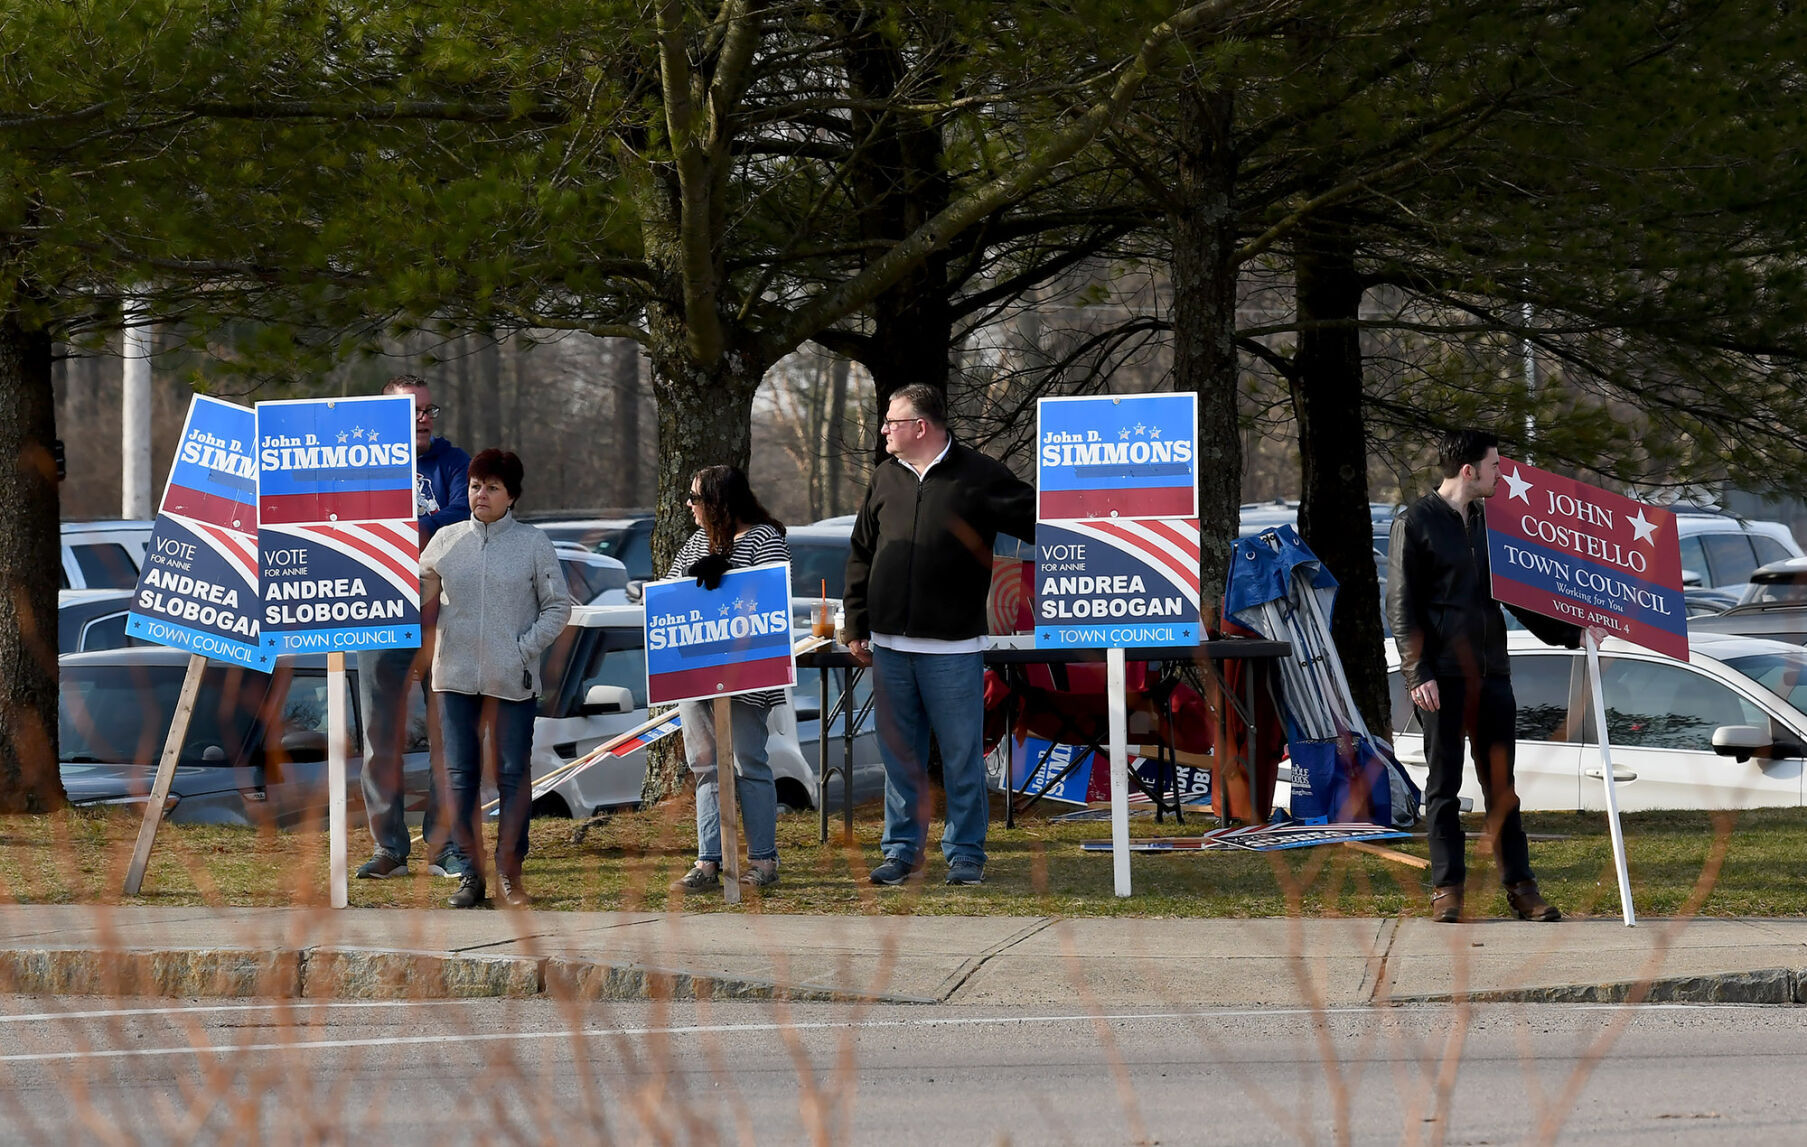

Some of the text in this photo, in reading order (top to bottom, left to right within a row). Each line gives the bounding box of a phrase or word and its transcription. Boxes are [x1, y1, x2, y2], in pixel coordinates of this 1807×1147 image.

[188, 429, 243, 453] John D.
[261, 434, 320, 448] John D.
[1043, 430, 1102, 444] John D.
[181, 441, 257, 481] SIMM
[261, 443, 410, 471] SIMMONS
[1042, 440, 1193, 468] SIMMONS
[1546, 490, 1614, 530] JOHN
[156, 536, 197, 561] VOTE
[1041, 544, 1087, 561] VOTE
[1521, 514, 1647, 573] COSTELLO
[150, 554, 192, 572] FOR ANNIE
[264, 549, 308, 566] VOTE
[1041, 562, 1086, 572] FOR ANNIE
[264, 567, 308, 577] FOR ANNIE
[1503, 545, 1671, 615] TOWN COUNCIL
[144, 568, 238, 609] ANDREA
[265, 578, 368, 601] ANDREA
[1041, 576, 1146, 596] ANDREA
[1556, 582, 1624, 612] Working for You
[265, 599, 404, 625] SLOBOGAN
[649, 610, 704, 628] John D.
[1041, 597, 1183, 619] SLOBOGAN
[1552, 600, 1630, 634] VOTE APRIL 4
[148, 622, 252, 662] TOWN COUNCIL
[283, 630, 397, 649] TOWN COUNCIL
[649, 610, 788, 651] SIMMONS
[1059, 628, 1176, 644] TOWN COUNCIL
